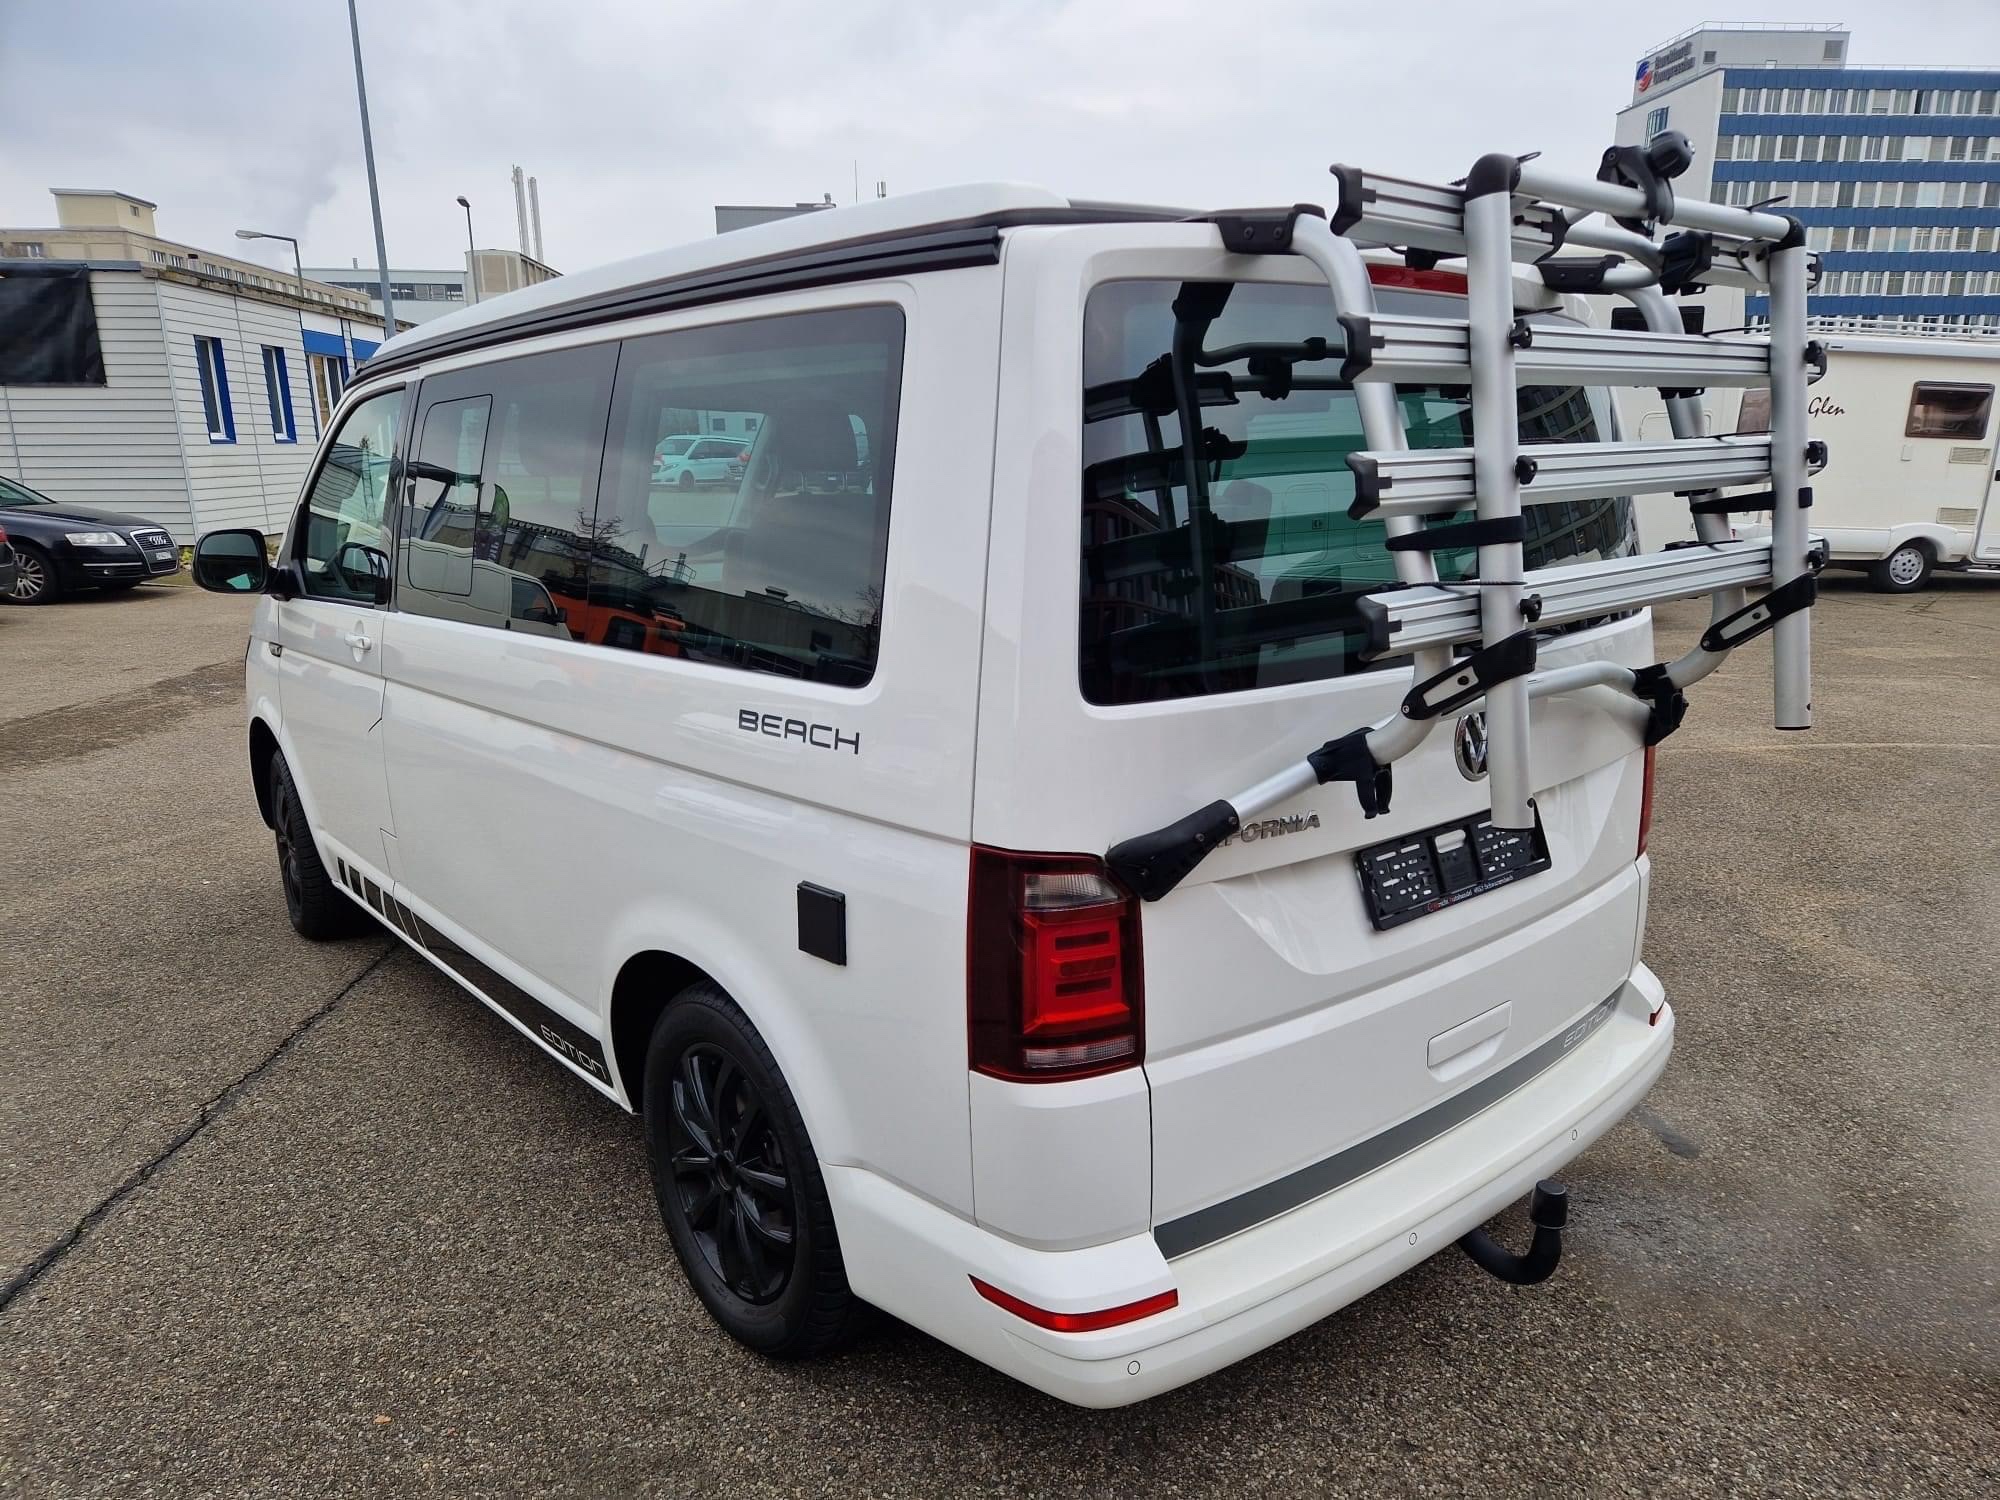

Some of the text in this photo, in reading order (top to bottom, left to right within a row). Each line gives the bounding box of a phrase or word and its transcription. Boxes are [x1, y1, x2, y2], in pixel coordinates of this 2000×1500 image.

[1808, 396, 1845, 418] Glen
[739, 709, 859, 755] BEACH
[1563, 998, 1615, 1048] EDITION
[541, 1024, 606, 1080] EDITION
